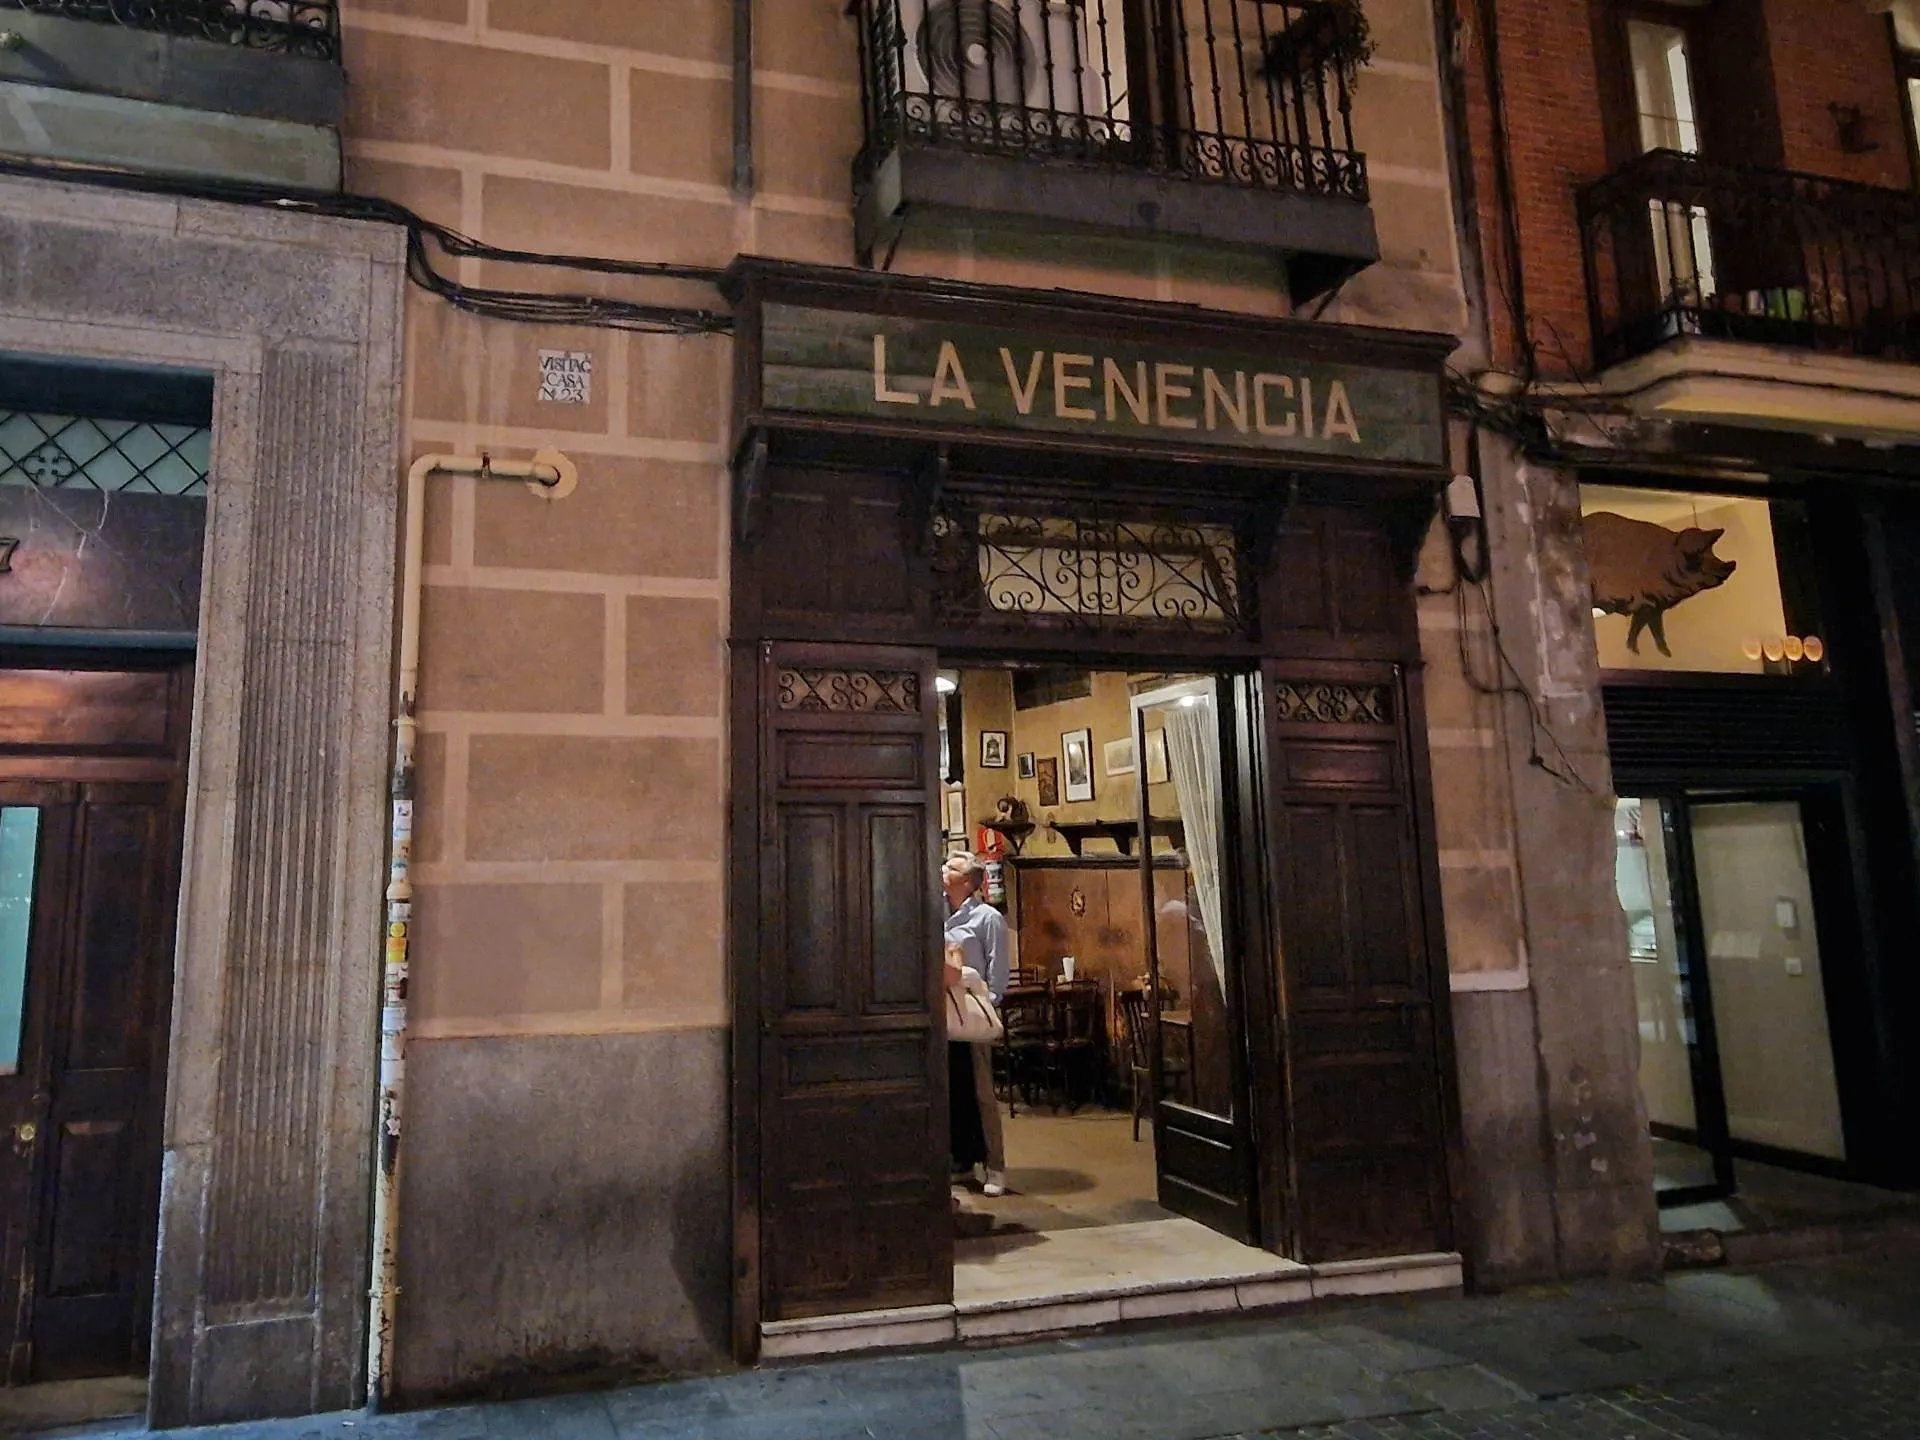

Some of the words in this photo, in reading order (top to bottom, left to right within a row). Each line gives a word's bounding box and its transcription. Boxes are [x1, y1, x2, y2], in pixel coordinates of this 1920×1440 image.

[546, 372, 585, 389] CASA
[873, 334, 977, 410] LA
[999, 348, 1361, 443] VENENCIA
